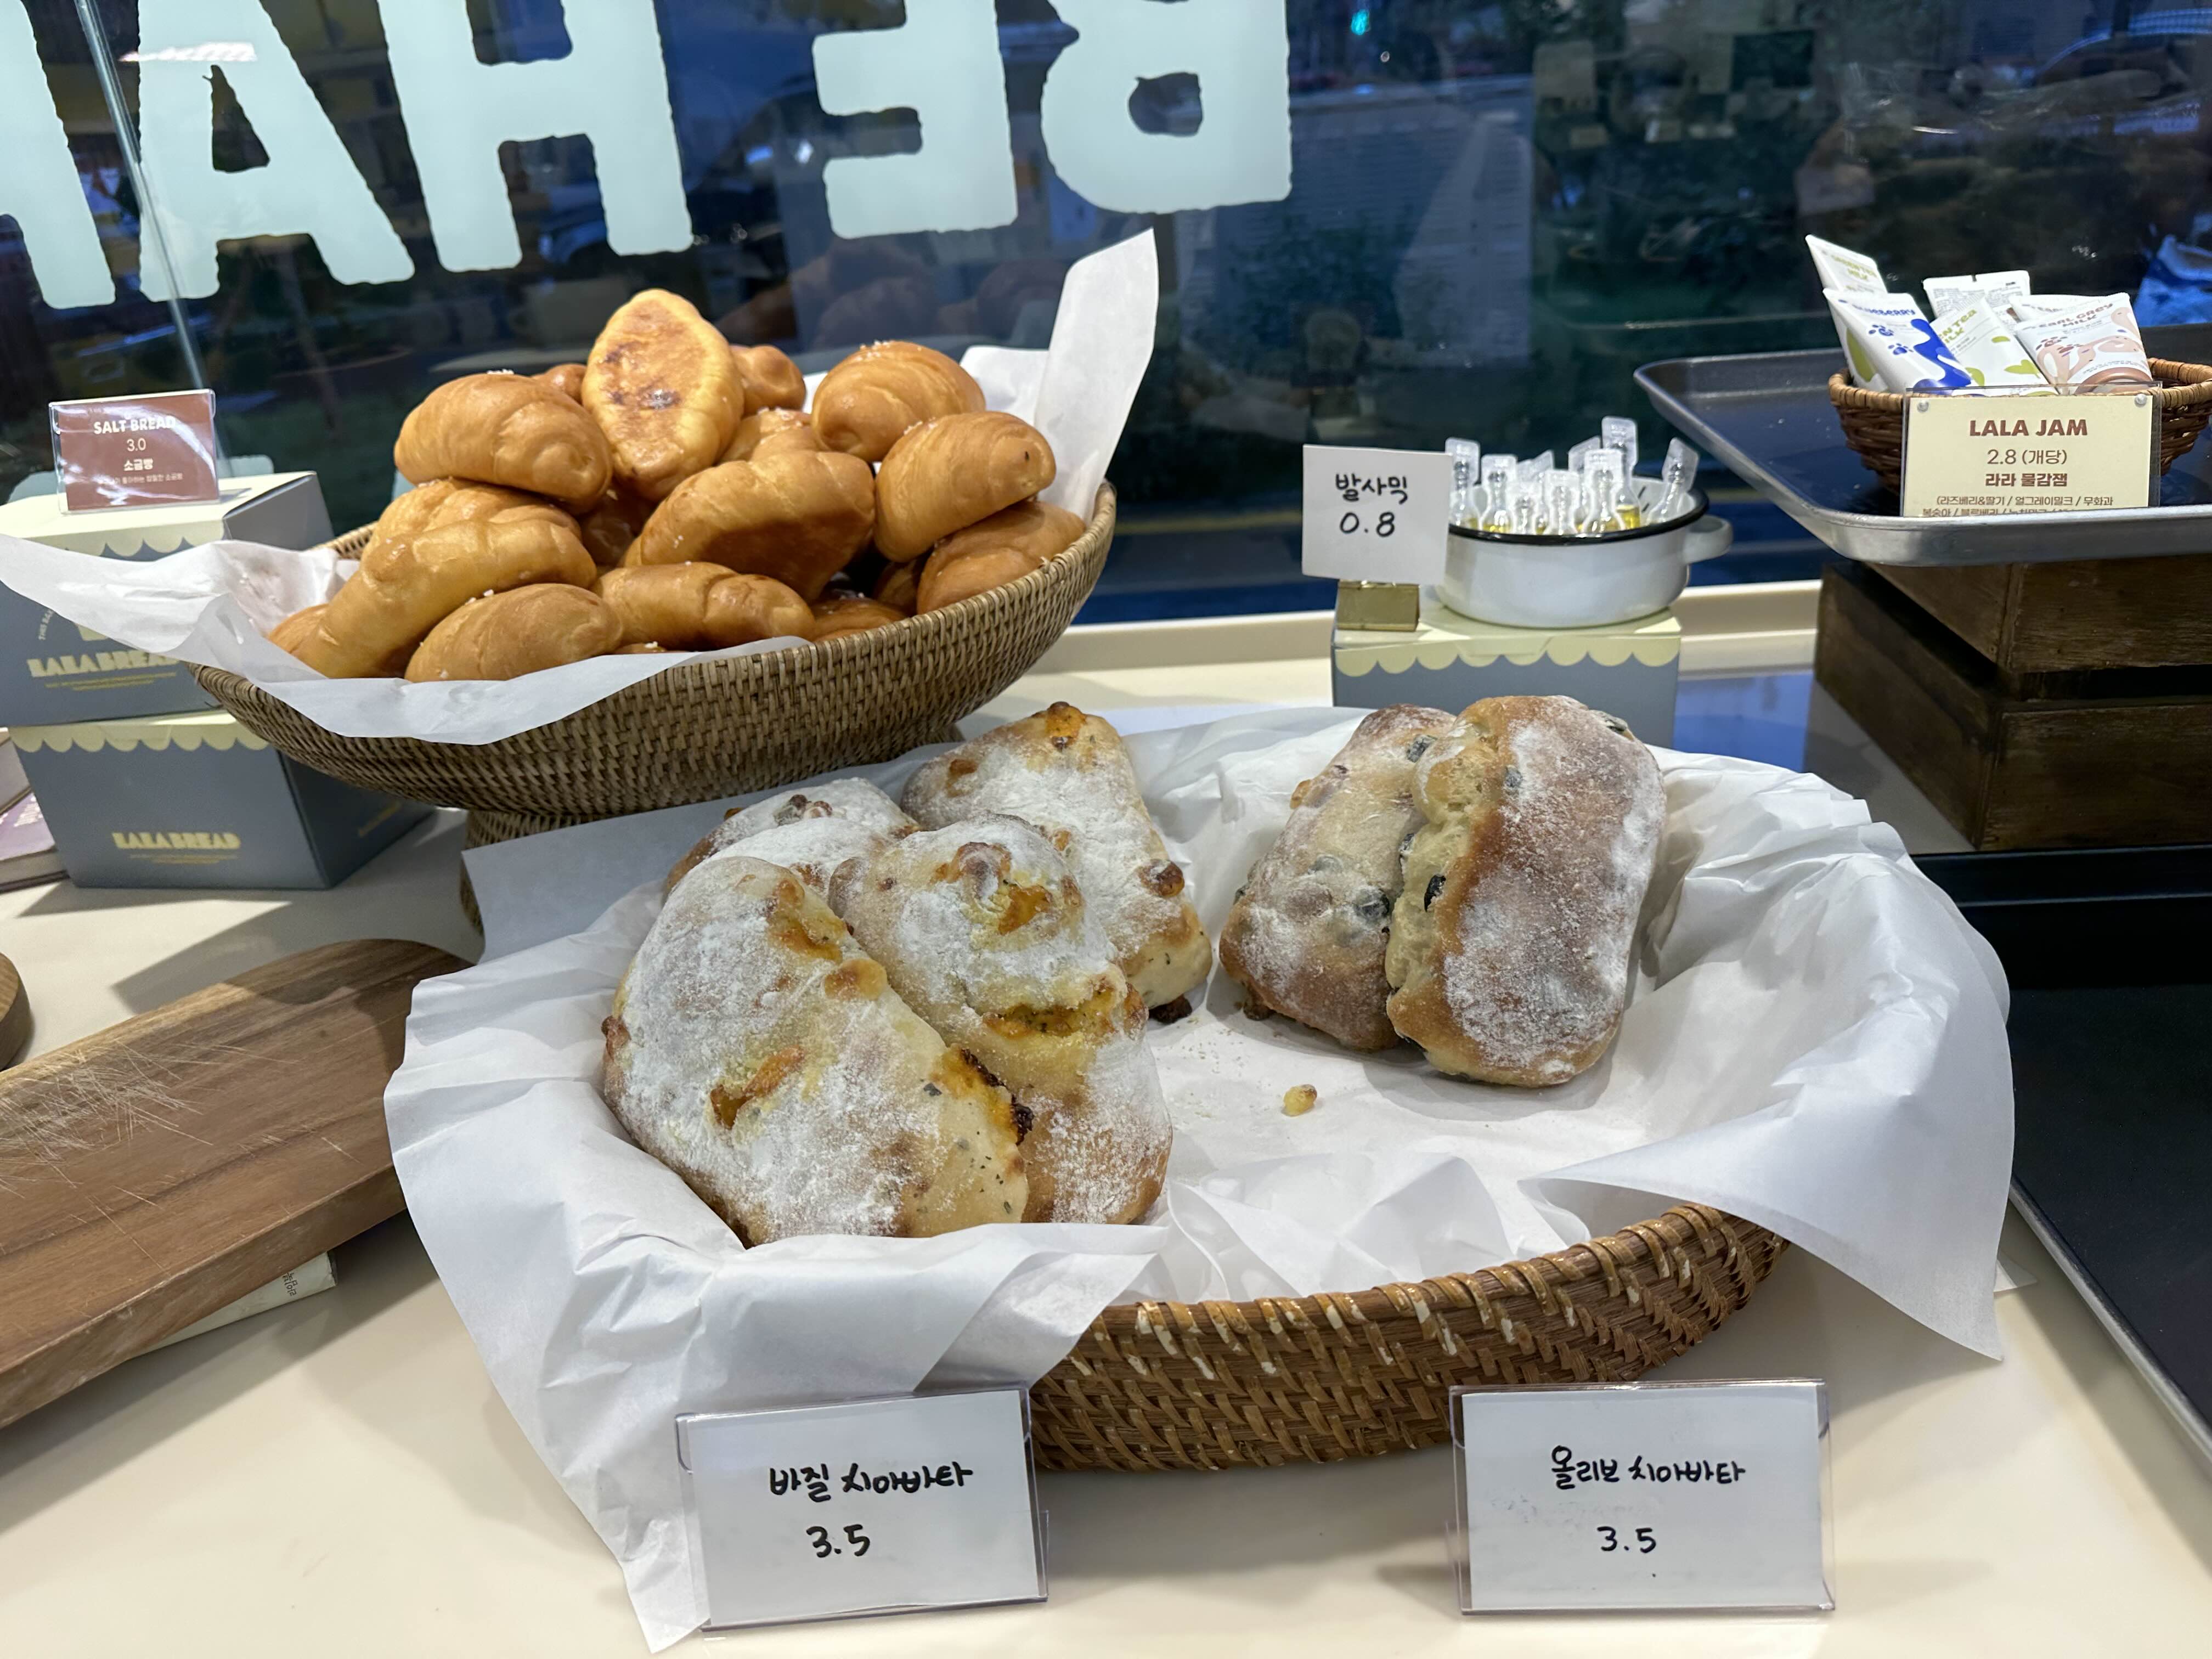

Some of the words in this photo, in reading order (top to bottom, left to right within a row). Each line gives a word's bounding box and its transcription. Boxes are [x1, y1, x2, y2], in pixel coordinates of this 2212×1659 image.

[1944, 328, 1965, 343] ILK
[94, 421, 127, 435] SALT
[131, 416, 176, 432] BREAD
[1969, 419, 2029, 437] LALA
[2035, 419, 2088, 436] JAM
[126, 438, 146, 452] 3.0
[123, 458, 154, 472] 소금빵
[1987, 449, 2017, 465] 2.8
[2022, 449, 2068, 465] (개당)
[1335, 473, 1408, 505] 발사믹
[1985, 473, 2017, 487] 라라
[2021, 473, 2068, 487] 물감잼
[1936, 495, 2005, 506] (라즈베리&딸기
[2015, 495, 2073, 506] 얼그레이밀크
[2083, 496, 2114, 506] 무화과
[1340, 511, 1395, 538] 0.8
[1551, 1445, 1620, 1490] 올리브
[1628, 1455, 1746, 1485] 치아바타
[770, 1463, 832, 1503] 바질
[840, 1461, 973, 1493] 치아바타
[806, 1523, 871, 1559] 3.5
[1596, 1526, 1657, 1554] 3.5
